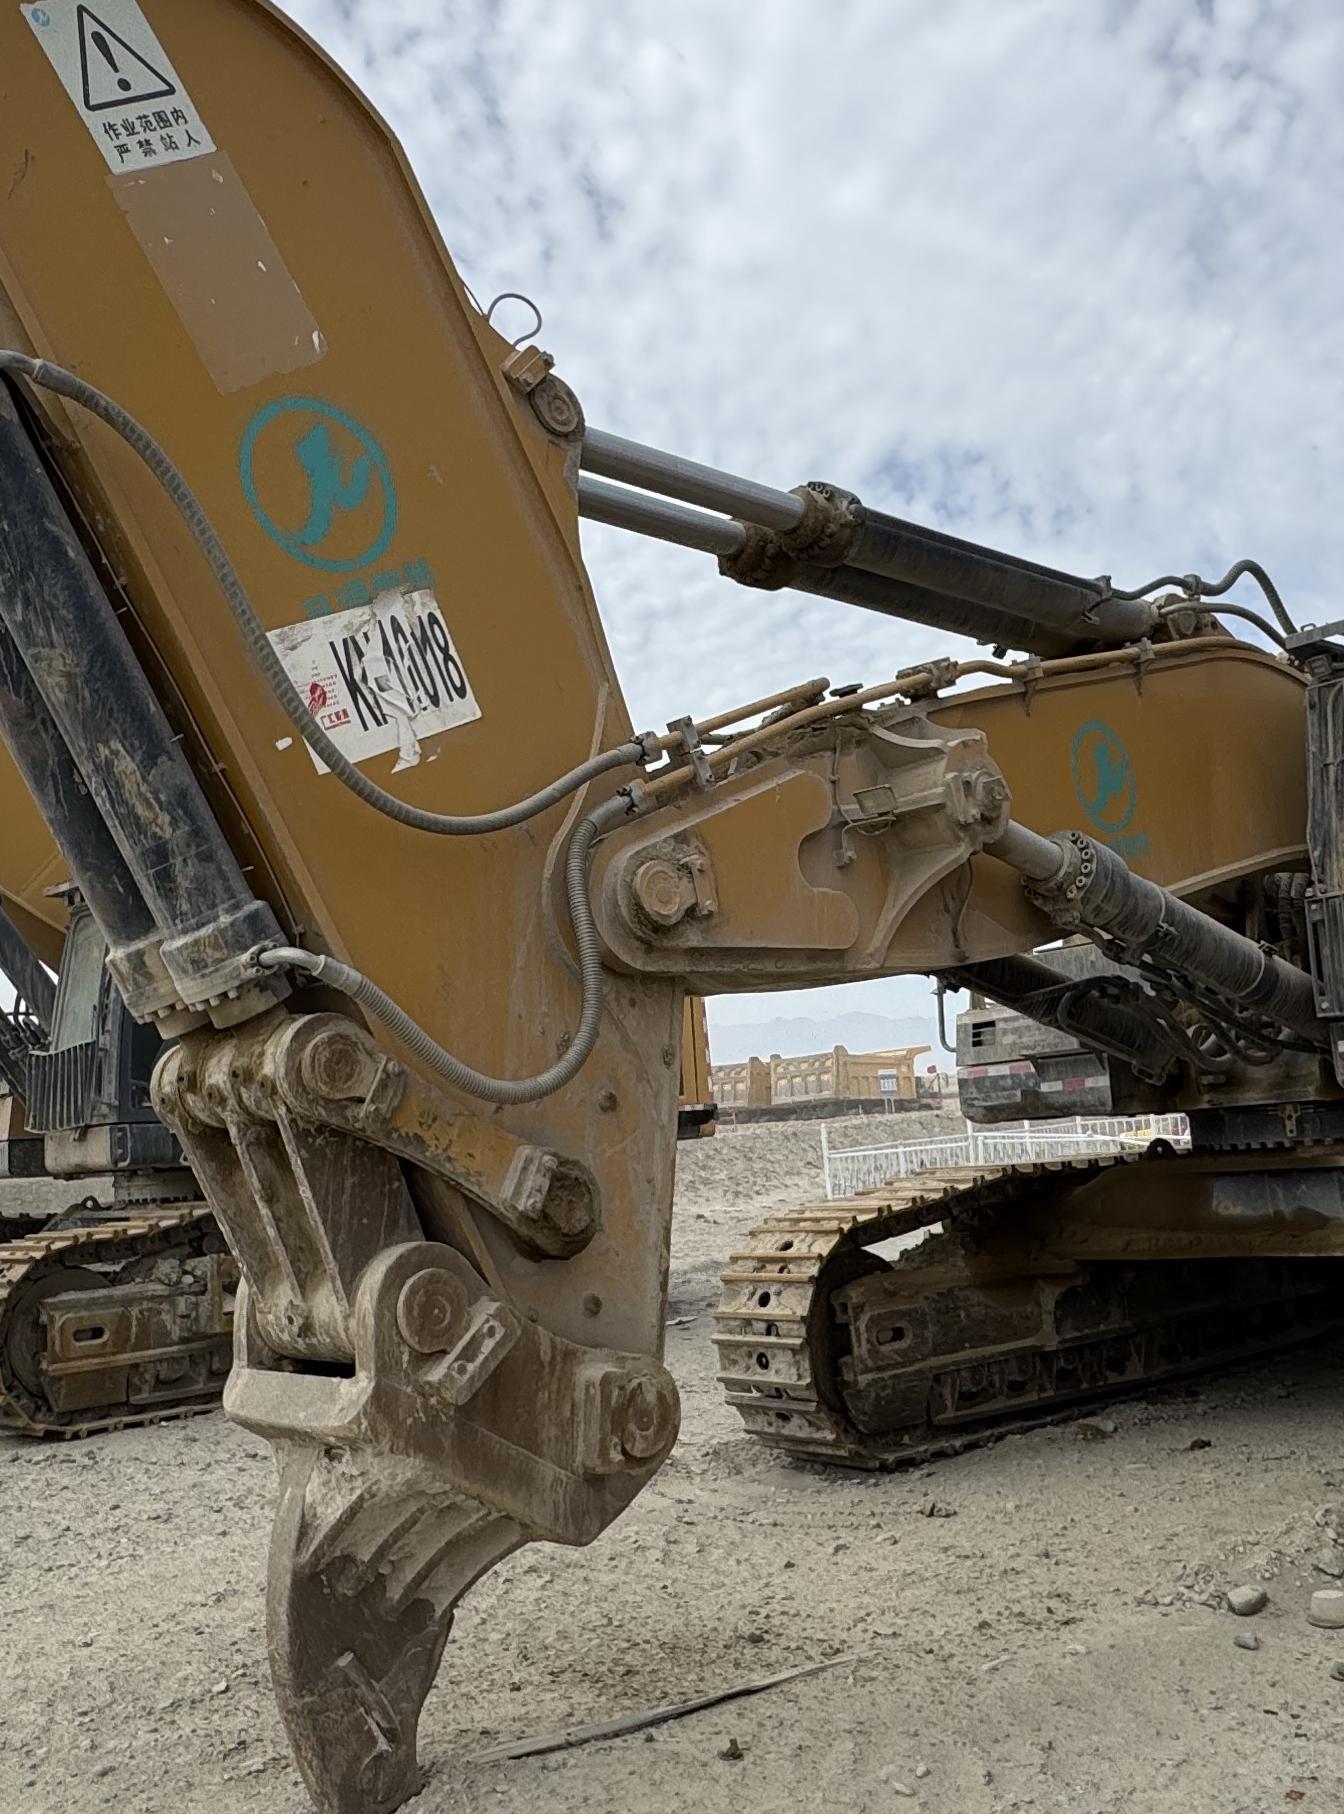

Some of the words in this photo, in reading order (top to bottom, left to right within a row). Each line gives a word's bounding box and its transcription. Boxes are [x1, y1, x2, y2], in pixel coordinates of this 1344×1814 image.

[102, 107, 188, 140] 作业范围内
[114, 130, 201, 163] 严禁站人
